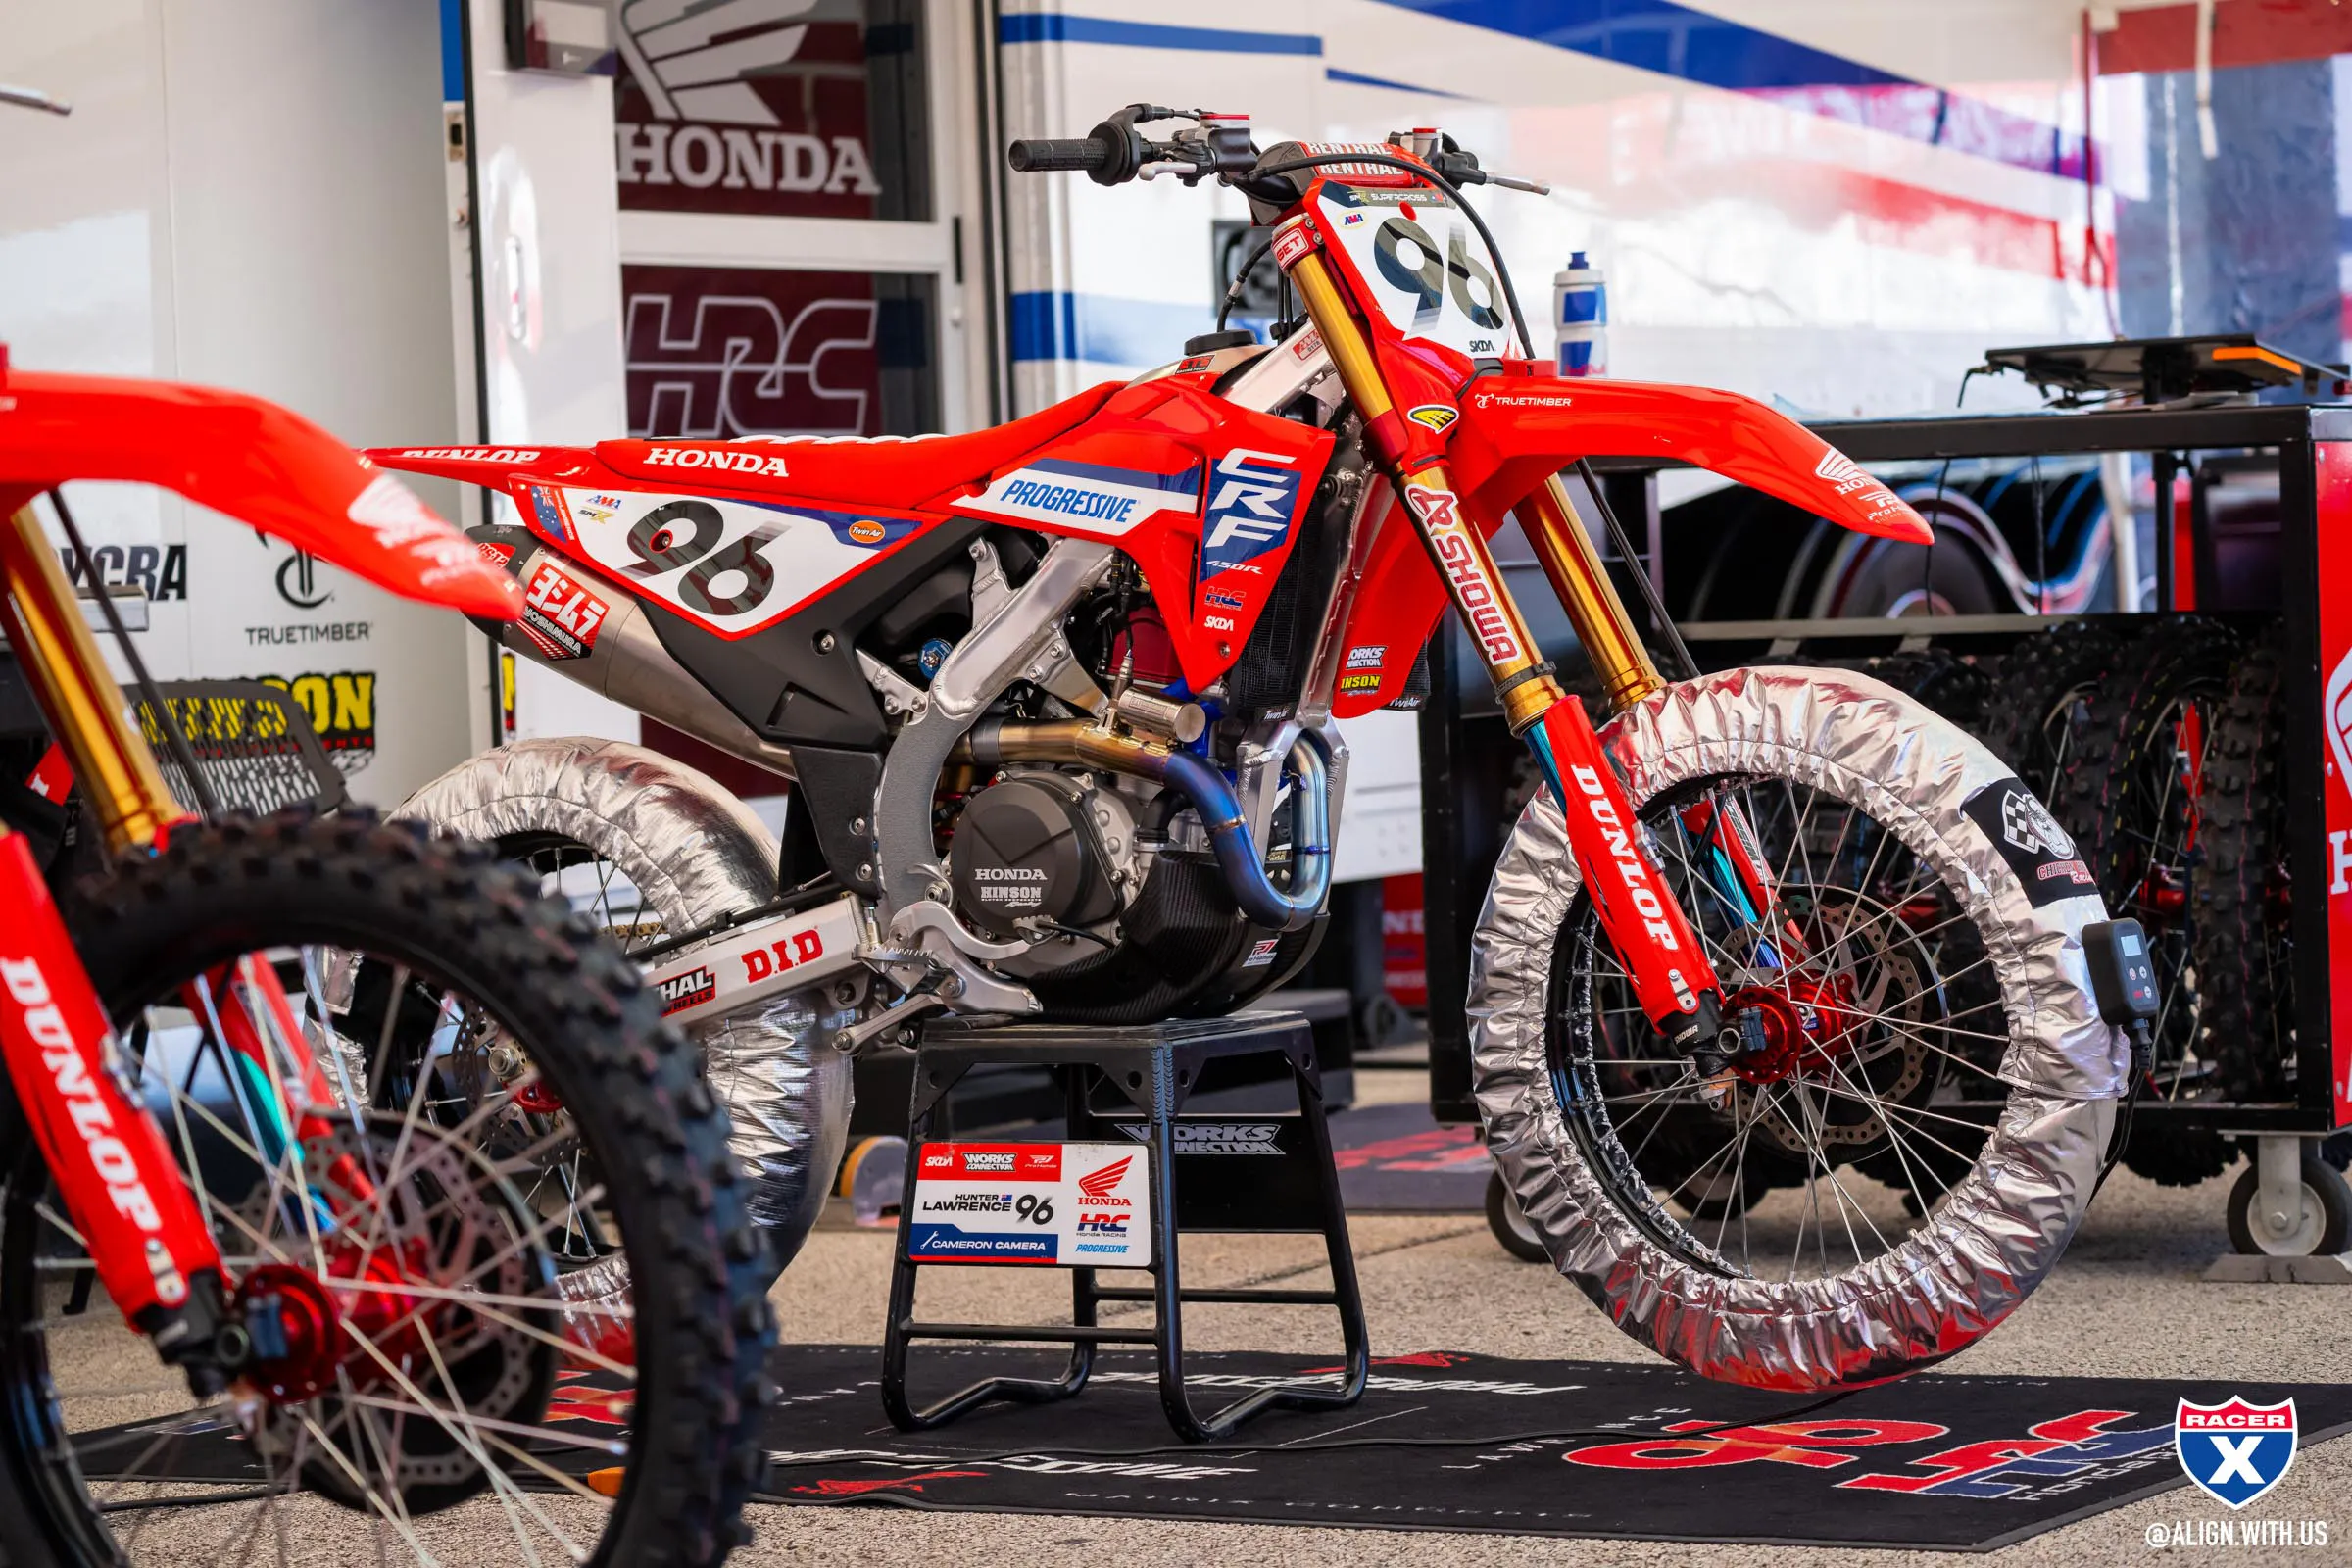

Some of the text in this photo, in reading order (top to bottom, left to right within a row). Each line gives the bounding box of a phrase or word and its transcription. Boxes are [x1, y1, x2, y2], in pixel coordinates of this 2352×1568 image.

[1303, 141, 1393, 155] RENTHAL
[616, 122, 882, 195] HONDA
[1371, 193, 1428, 202] SUPERCROSS
[1344, 214, 1363, 226] AMA
[1276, 236, 1299, 262] GET
[1374, 217, 1504, 338] 96
[1469, 340, 1495, 352] SKDA
[624, 294, 879, 438] HRC
[1495, 397, 1572, 407] TRUETIMBER
[401, 449, 541, 465] DUNLOP
[643, 447, 789, 477] HONDA
[587, 494, 622, 510] AMA
[1000, 479, 1137, 523] PROGRESSIVE
[1204, 448, 1297, 548] CRF
[851, 525, 882, 537] Twin Air
[617, 500, 791, 615] 96
[1205, 560, 1264, 575] 450R
[526, 566, 606, 638] ヨシムラ
[1435, 534, 1519, 662] SHOWA
[523, 607, 582, 655] YOSHIMURA
[1204, 615, 1234, 631] SKDA
[246, 622, 370, 646] TRUETIMBER
[1348, 648, 1386, 661] ORKS
[1341, 675, 1380, 689] INSON
[1570, 764, 1678, 952] DUNLOP
[974, 868, 1048, 881] HONDA
[980, 886, 1042, 899] HINSON
[740, 929, 824, 984] D.I.D
[1673, 1024, 1698, 1046] SHOWA
[0, 956, 163, 1233] DUNLOP
[1175, 1141, 1278, 1152] NECTION
[925, 1156, 953, 1167] SKDA
[965, 1153, 1014, 1164] WORKS
[922, 1201, 1011, 1212] LAWRENCE
[1015, 1194, 1054, 1225] 96
[1078, 1197, 1132, 1206] HONDA
[1078, 1213, 1130, 1232] HRC
[932, 1240, 1046, 1250] CAMERON CAMERA
[1076, 1244, 1130, 1253] PROGRESSIVE
[2010, 1459, 2157, 1501] Honda
